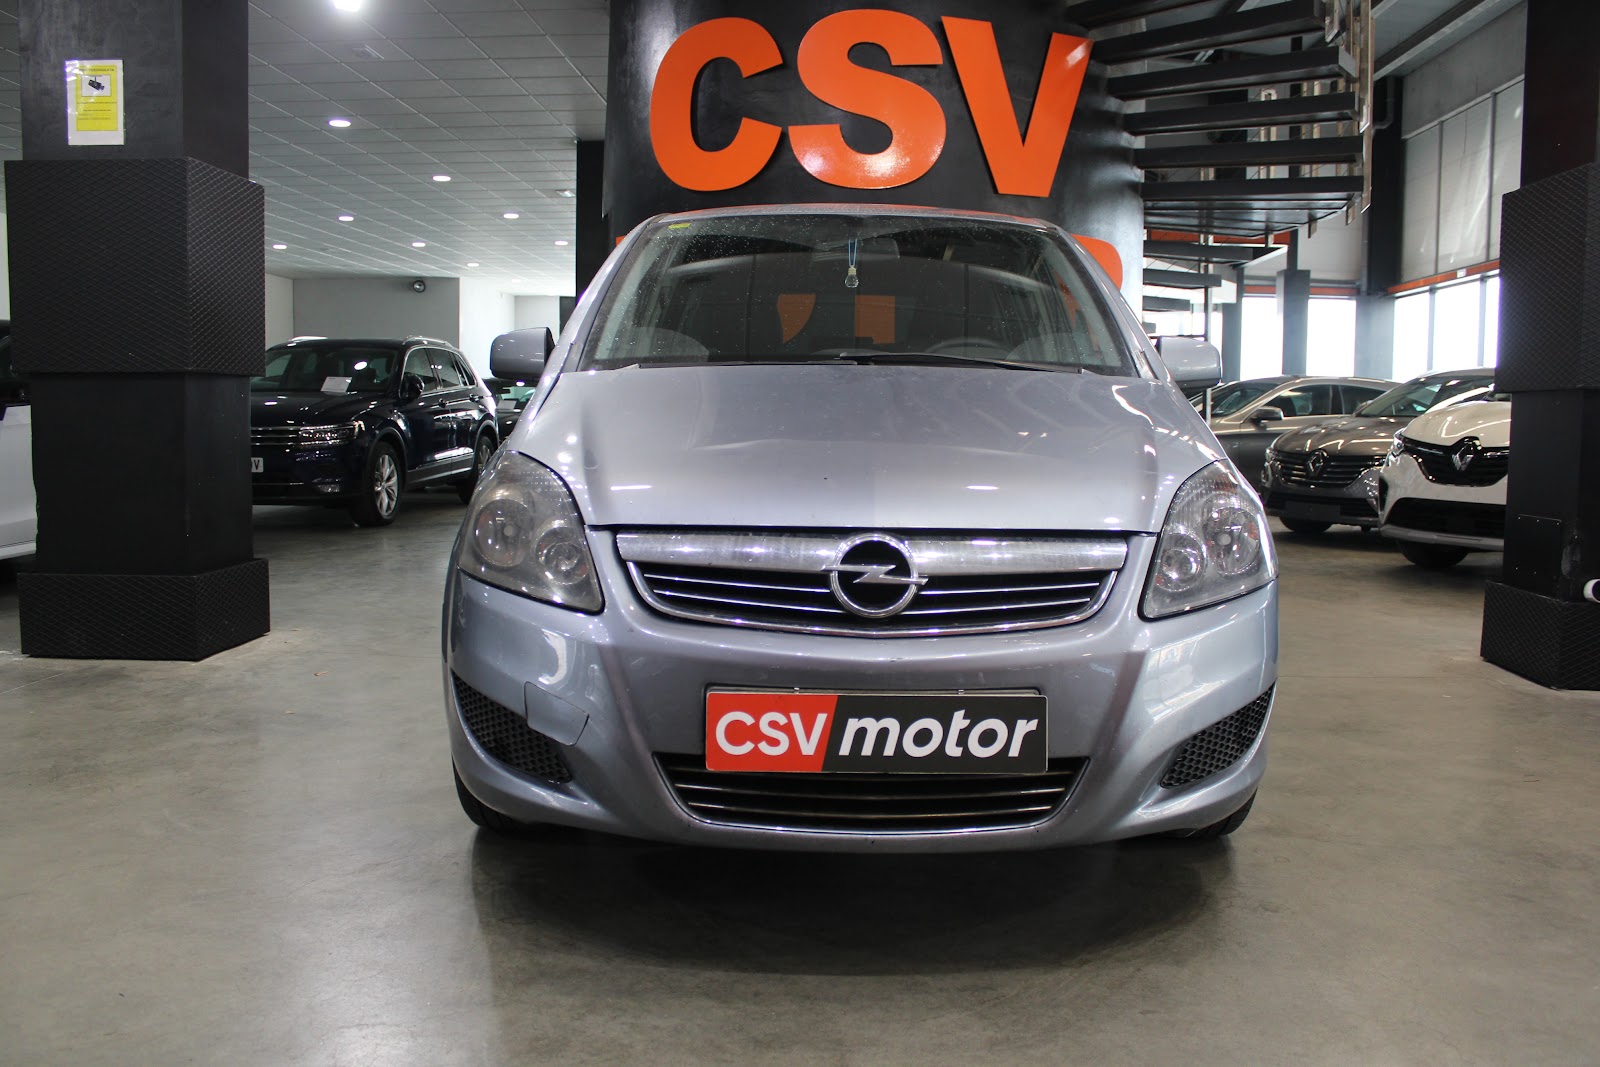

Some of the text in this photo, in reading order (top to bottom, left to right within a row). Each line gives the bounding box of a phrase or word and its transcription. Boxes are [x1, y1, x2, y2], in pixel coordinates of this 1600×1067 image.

[650, 9, 1092, 198] CSV
[715, 709, 1039, 758] CSV motor
